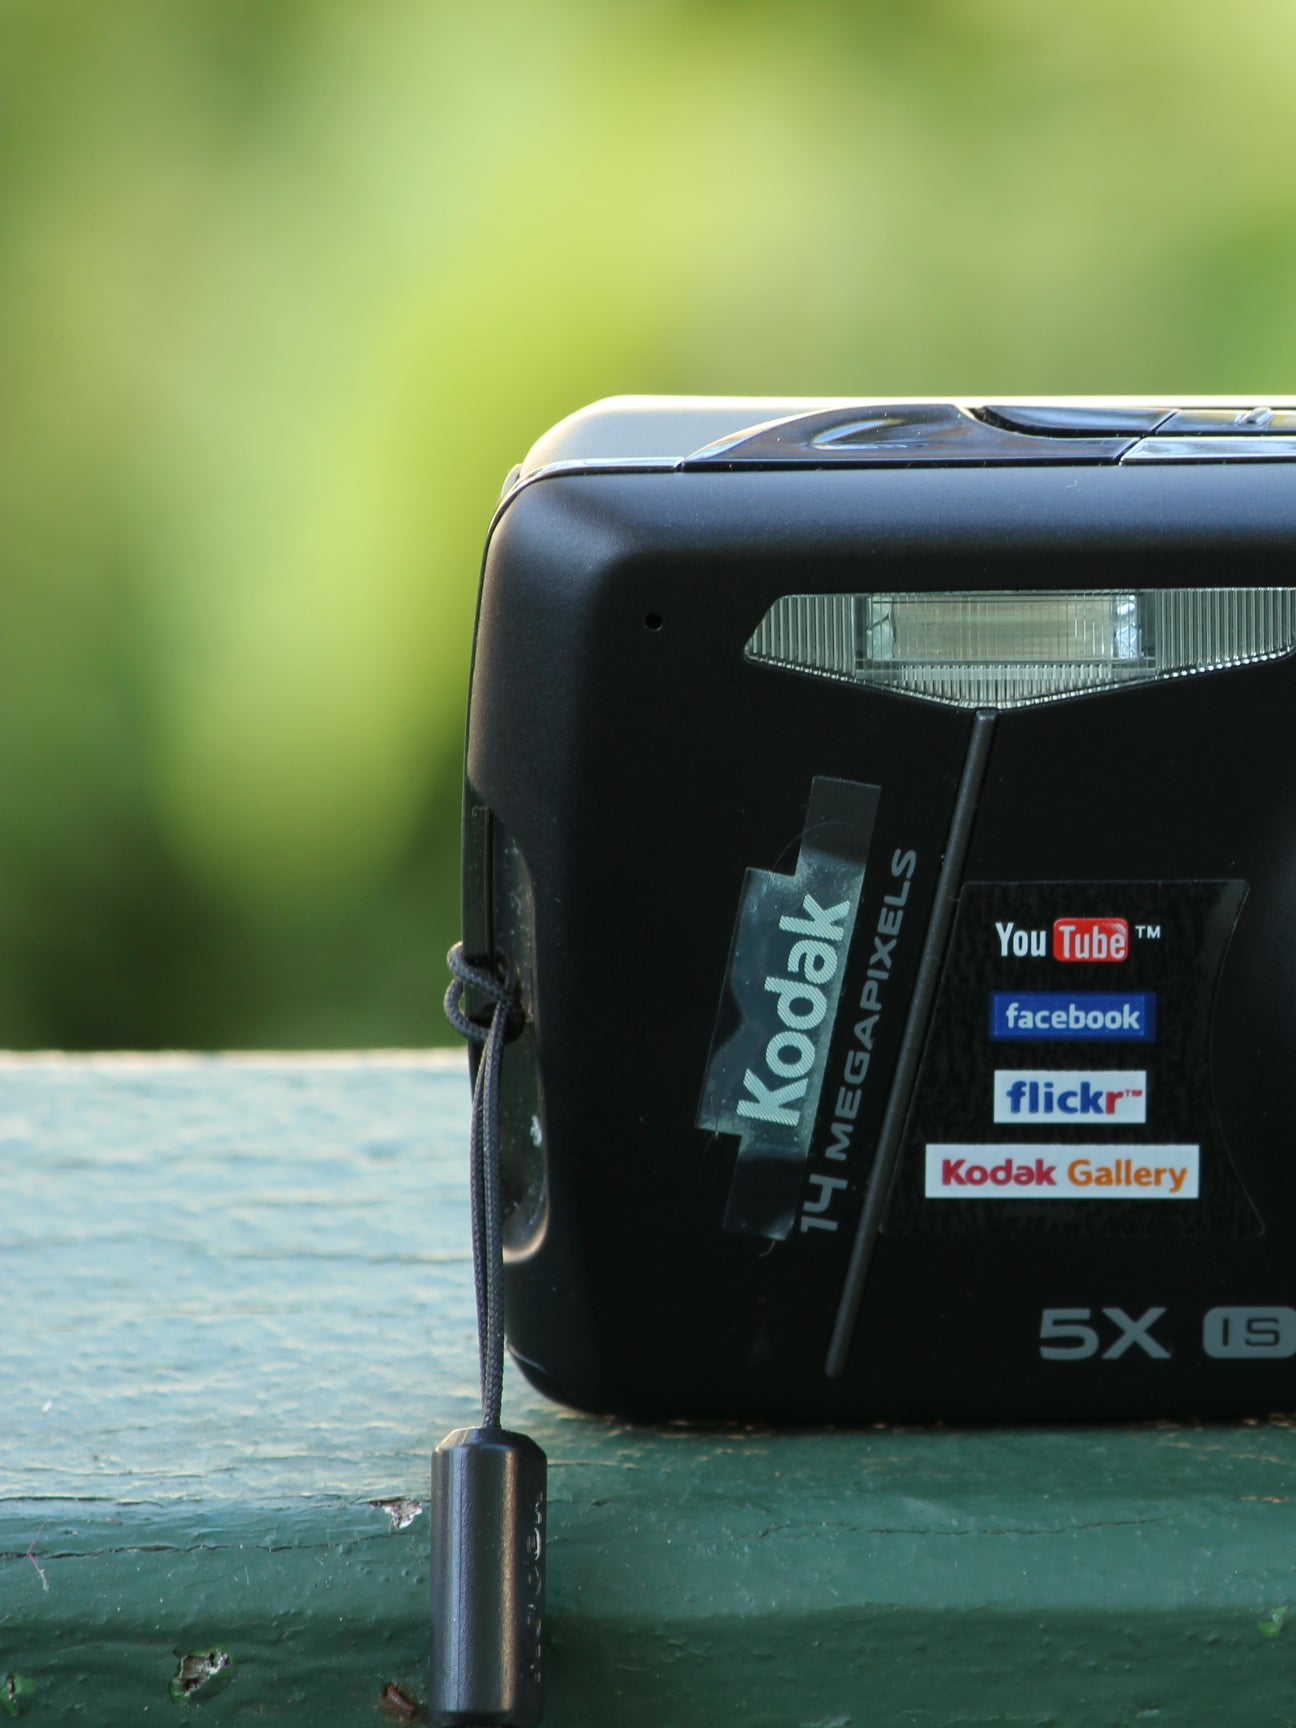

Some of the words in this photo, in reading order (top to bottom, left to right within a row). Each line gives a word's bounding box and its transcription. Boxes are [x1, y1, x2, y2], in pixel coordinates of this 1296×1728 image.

[736, 894, 851, 1127] Kodak
[824, 847, 917, 1162] MEGAPIXELS
[1005, 1002, 1141, 1030] facebook
[800, 1172, 849, 1234] 14
[941, 1158, 1057, 1186] Kodak
[1067, 1158, 1188, 1193] Gallery
[1038, 1306, 1172, 1360] 5X
[1219, 1317, 1281, 1348] IS
